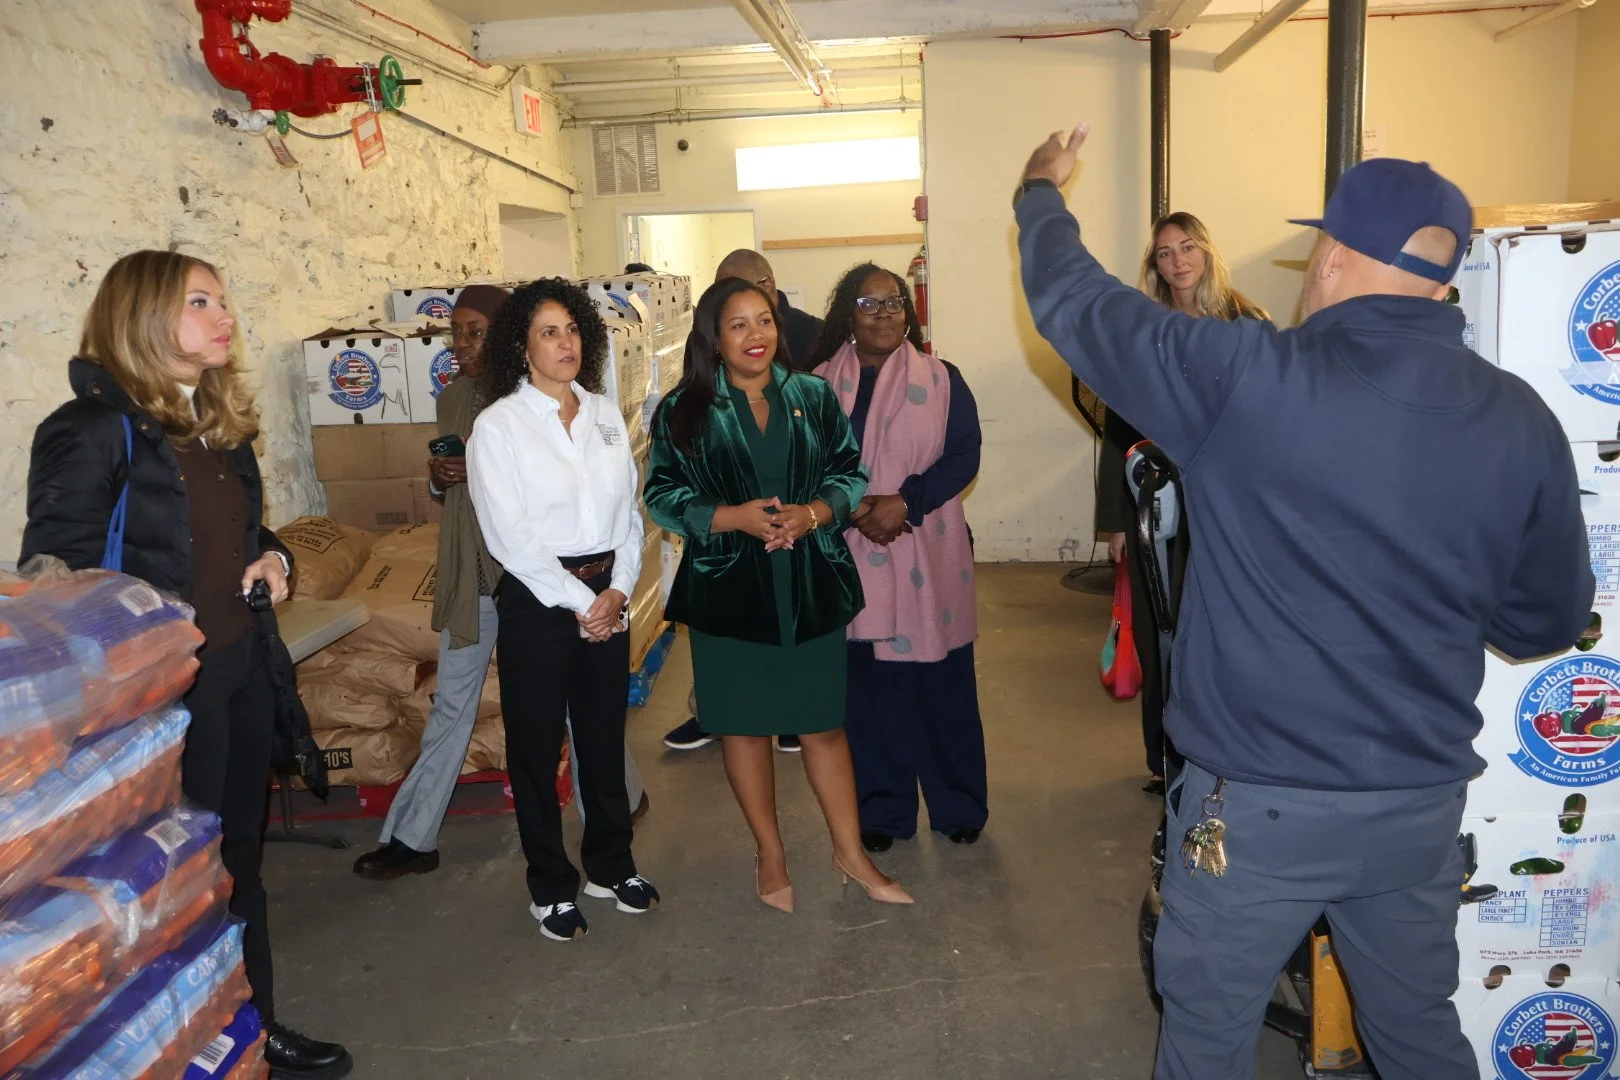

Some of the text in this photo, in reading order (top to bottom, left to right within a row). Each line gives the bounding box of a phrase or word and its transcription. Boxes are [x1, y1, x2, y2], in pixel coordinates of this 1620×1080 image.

[523, 93, 542, 134] EXIT
[1529, 664, 1576, 703] Corbett
[1552, 754, 1606, 770] Farms
[1530, 762, 1540, 772] An
[1540, 769, 1578, 783] American
[1580, 773, 1608, 783] Family
[1556, 834, 1616, 844] Produce of USA
[1494, 890, 1527, 898] PLANT
[1543, 887, 1589, 897] PEPPERS
[1504, 998, 1605, 1037] Corbett Brothers
